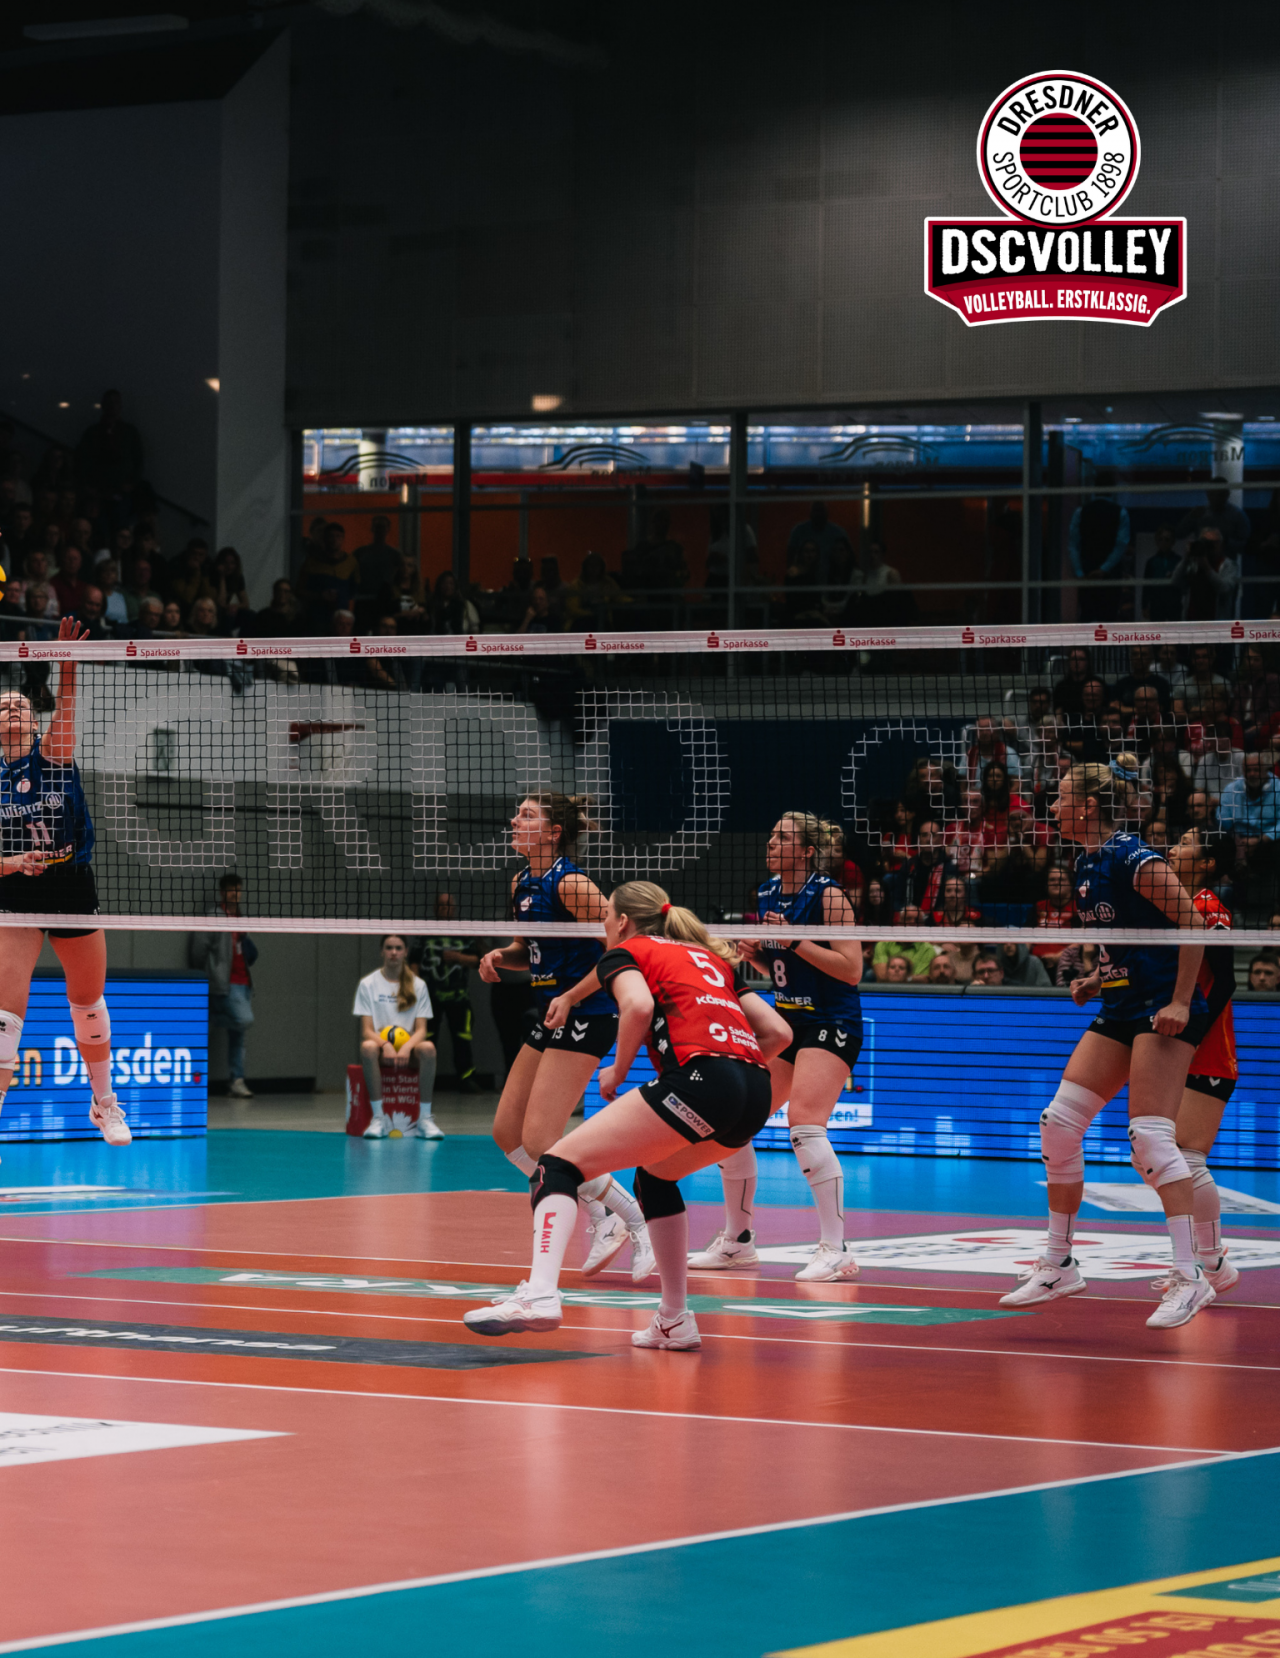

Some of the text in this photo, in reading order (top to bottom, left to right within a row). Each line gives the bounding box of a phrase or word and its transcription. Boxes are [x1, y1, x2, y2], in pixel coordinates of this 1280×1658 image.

[849, 636, 897, 648] Sparkasse
[979, 634, 1027, 645] Sparkasse
[1111, 632, 1162, 643] Sparkasse
[364, 644, 407, 655] Sparkasse
[481, 642, 524, 653] Sparkasse
[600, 640, 645, 652] Sparkasse
[723, 638, 769, 650] Sparkasse
[32, 648, 72, 660] Sparkasse
[140, 648, 181, 659] Sparkasse
[251, 645, 292, 656] Sparkasse
[25, 821, 53, 847] 11
[687, 950, 725, 988] 5
[773, 959, 788, 988] 8
[695, 993, 746, 1016] KÖRNE
[679, 1106, 712, 1135] POWER
